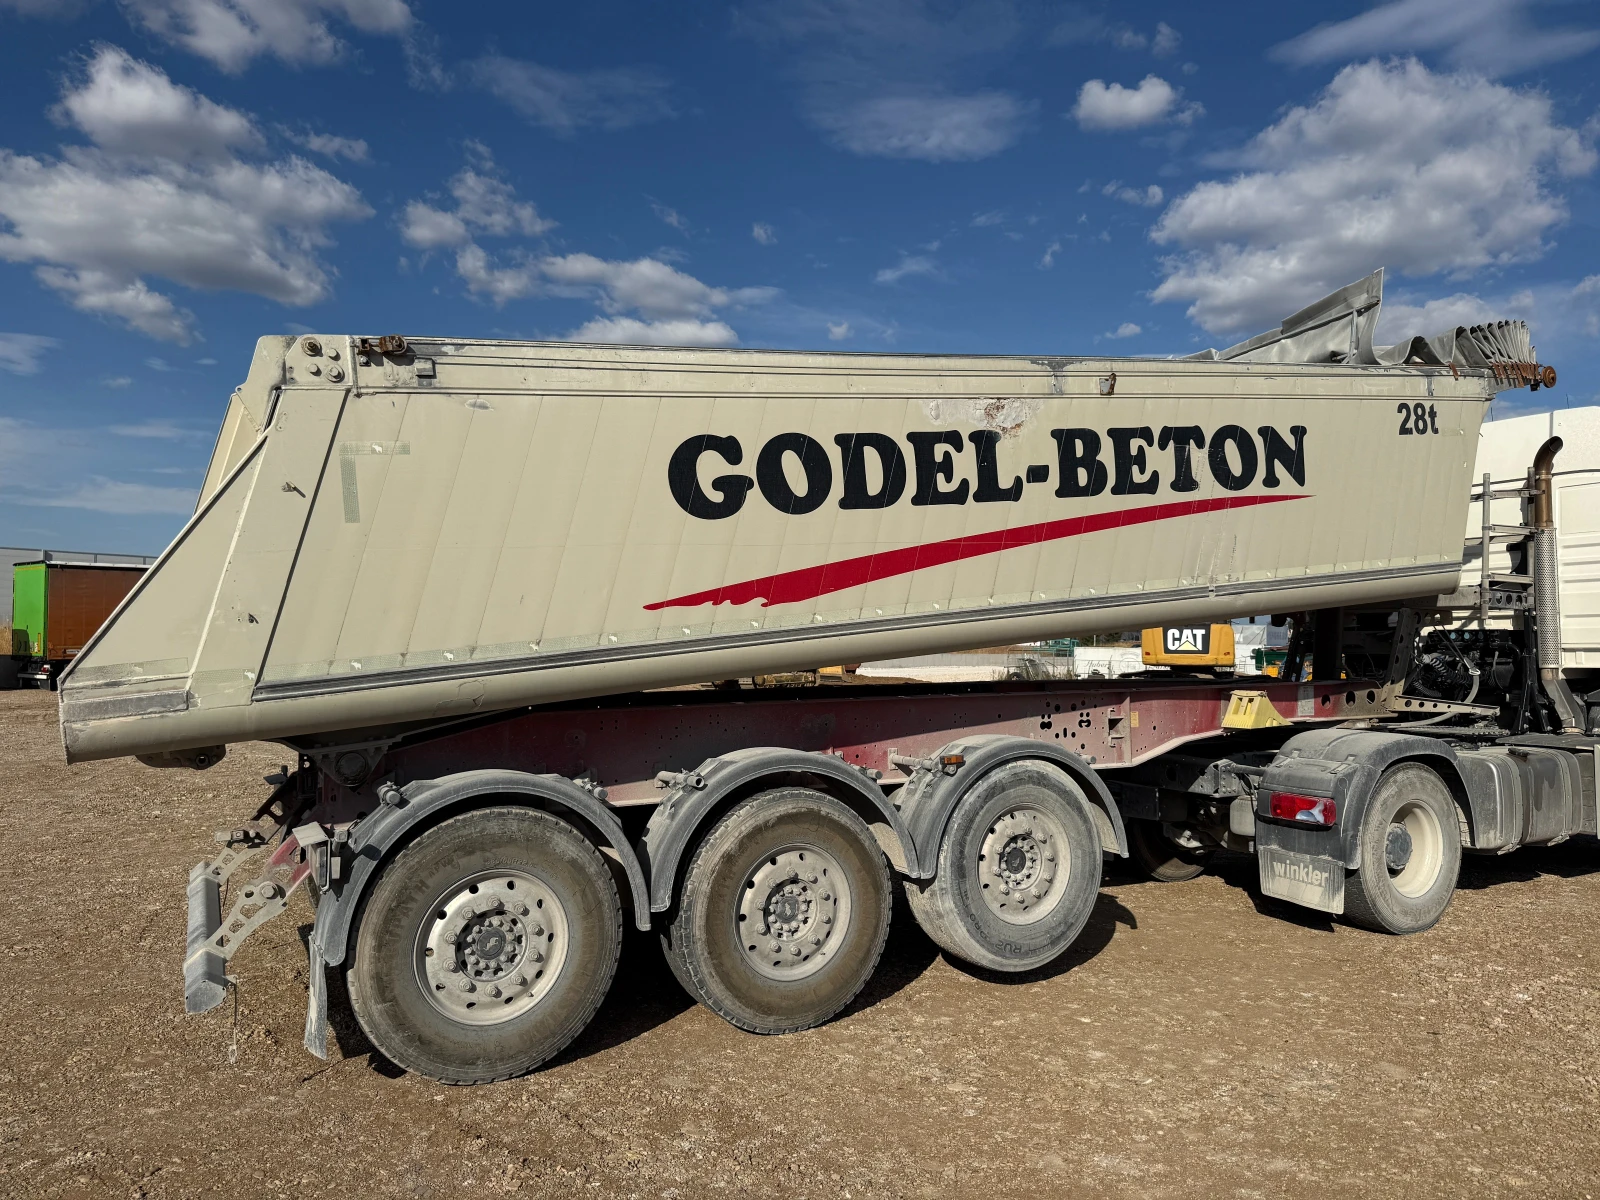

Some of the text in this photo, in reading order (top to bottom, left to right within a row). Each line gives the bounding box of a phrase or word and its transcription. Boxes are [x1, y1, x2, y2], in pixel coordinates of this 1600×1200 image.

[1397, 402, 1439, 435] 28t
[668, 424, 1306, 520] GODEL-BETON
[1167, 628, 1205, 652] CAT
[1272, 860, 1329, 887] winkler
